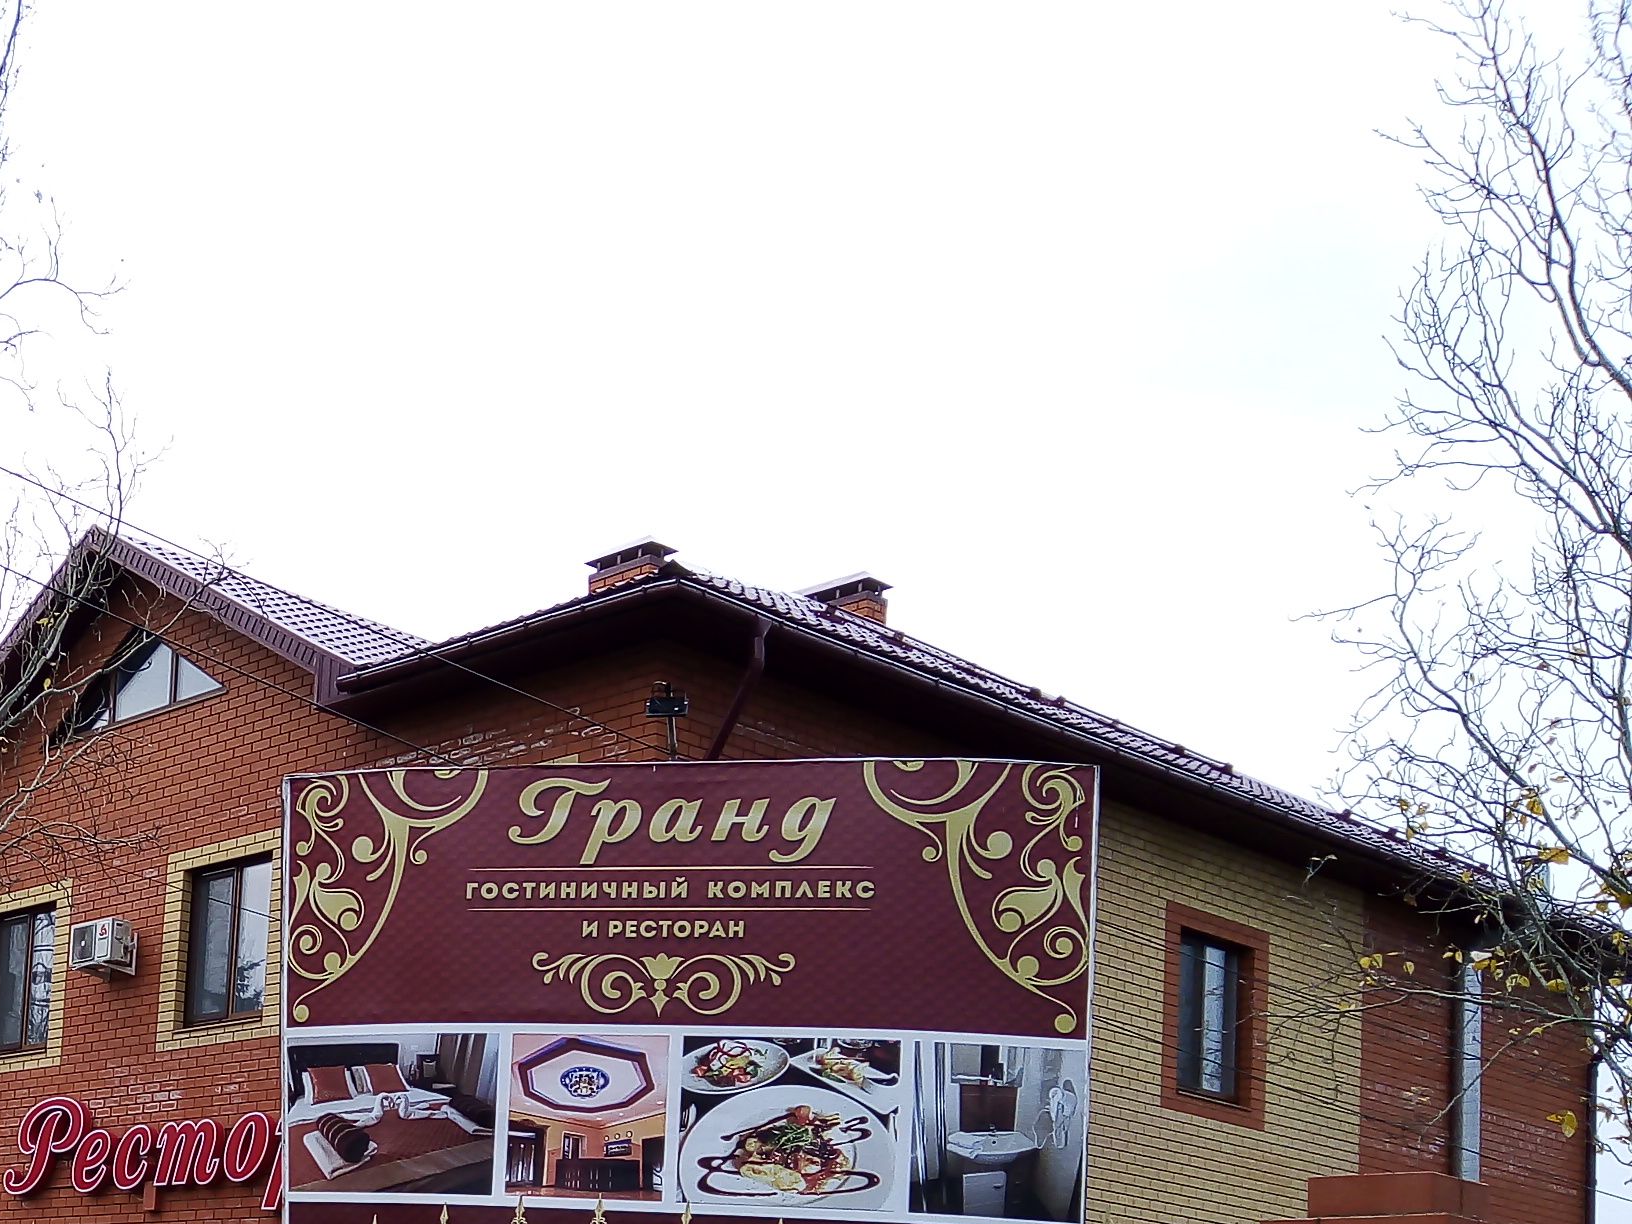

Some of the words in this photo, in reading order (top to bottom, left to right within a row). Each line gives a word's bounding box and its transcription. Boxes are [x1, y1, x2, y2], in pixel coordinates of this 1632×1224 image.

[508, 777, 837, 865] Гранд
[465, 876, 689, 900] ГОСТИНИЧНЫЙ
[706, 880, 877, 900] КОМПЛЕКС
[581, 920, 599, 939] И
[607, 919, 746, 939] РЕСТОРАН
